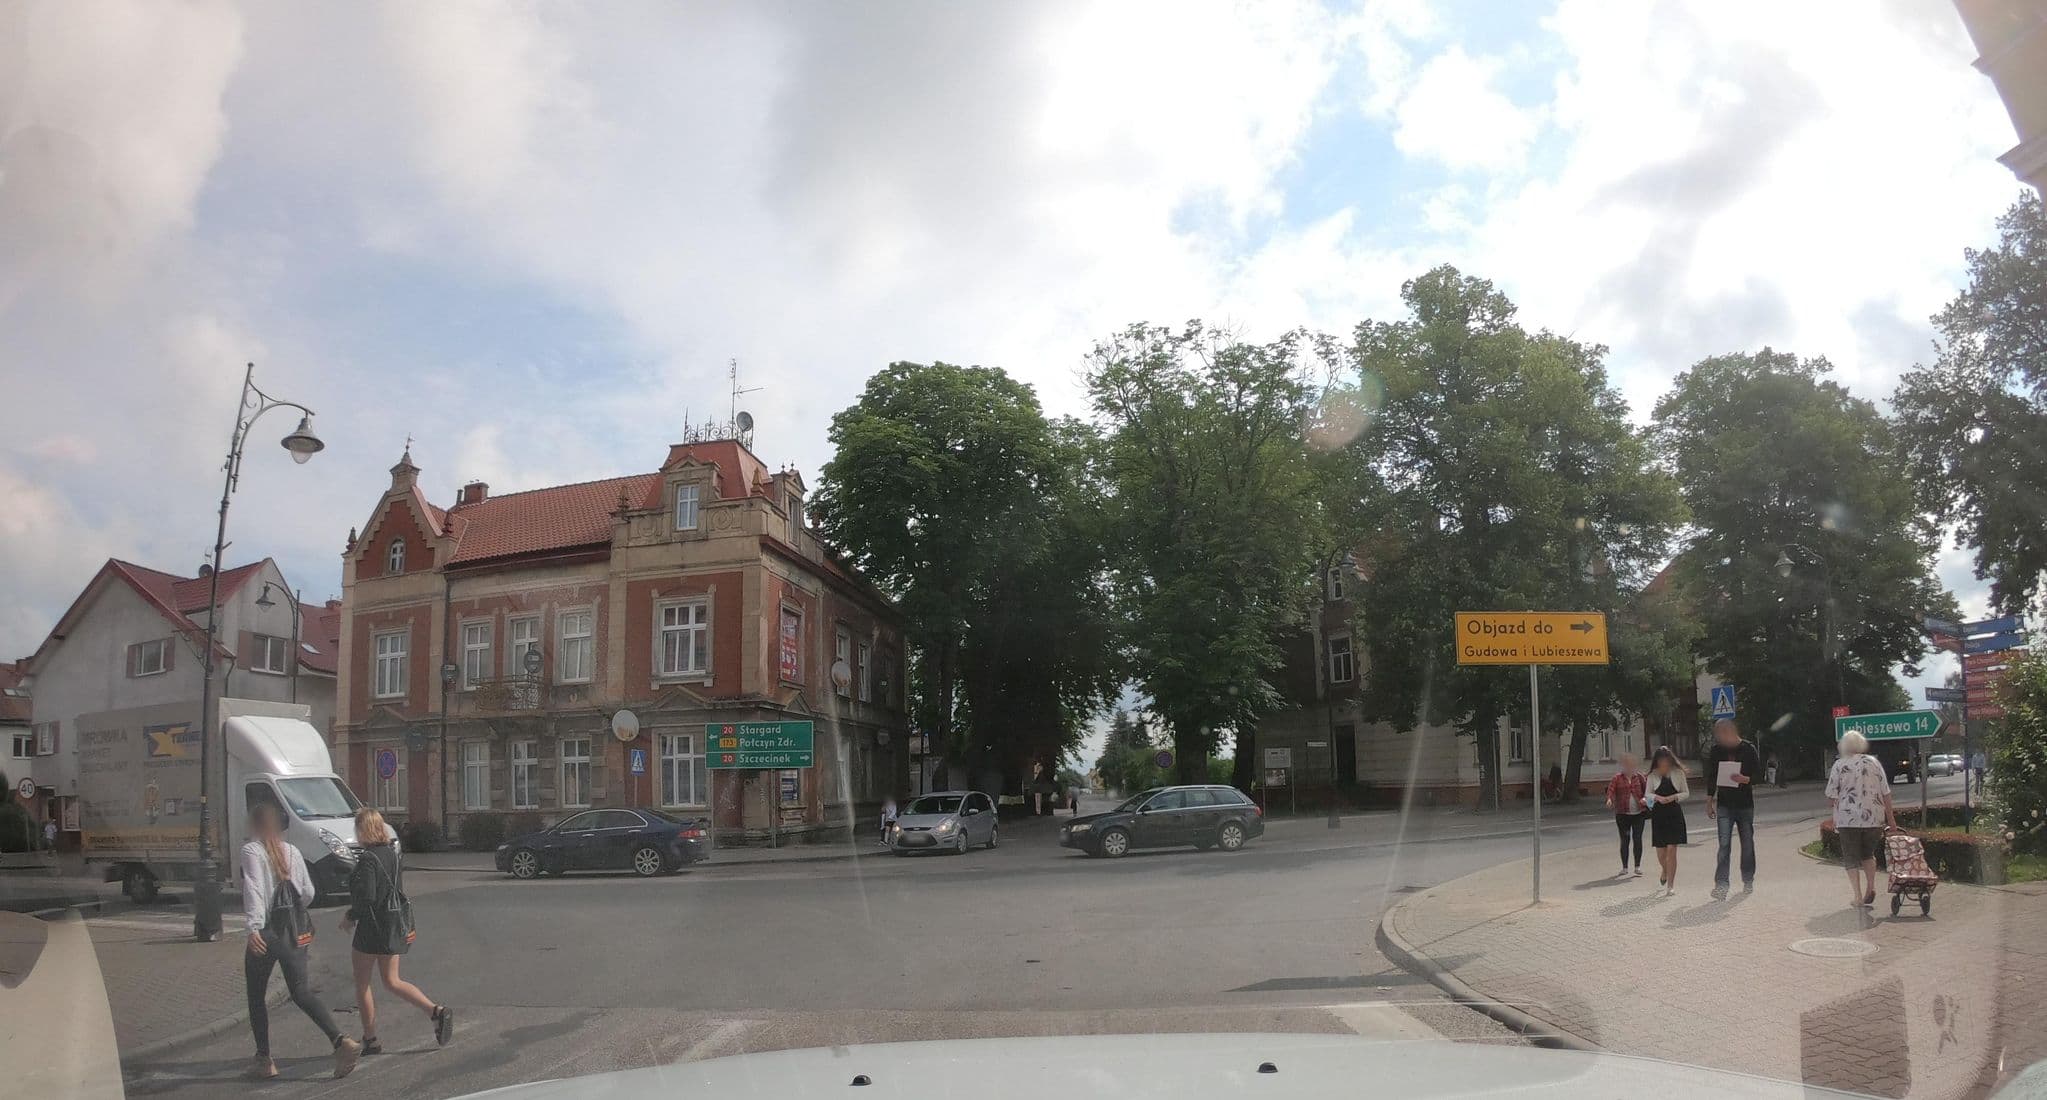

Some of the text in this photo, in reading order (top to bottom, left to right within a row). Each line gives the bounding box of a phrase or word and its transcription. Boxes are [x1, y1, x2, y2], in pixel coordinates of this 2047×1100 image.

[1467, 620, 1553, 638] Objazd do
[1464, 645, 1602, 657] Gudowa i Lubieszewa
[1915, 717, 1928, 731] 14
[723, 724, 782, 737] 20 Stargard
[740, 738, 775, 749] Połczyn
[777, 737, 796, 747] Zdr.
[723, 753, 791, 763] 20 Szczecinek
[21, 783, 33, 794] 40
